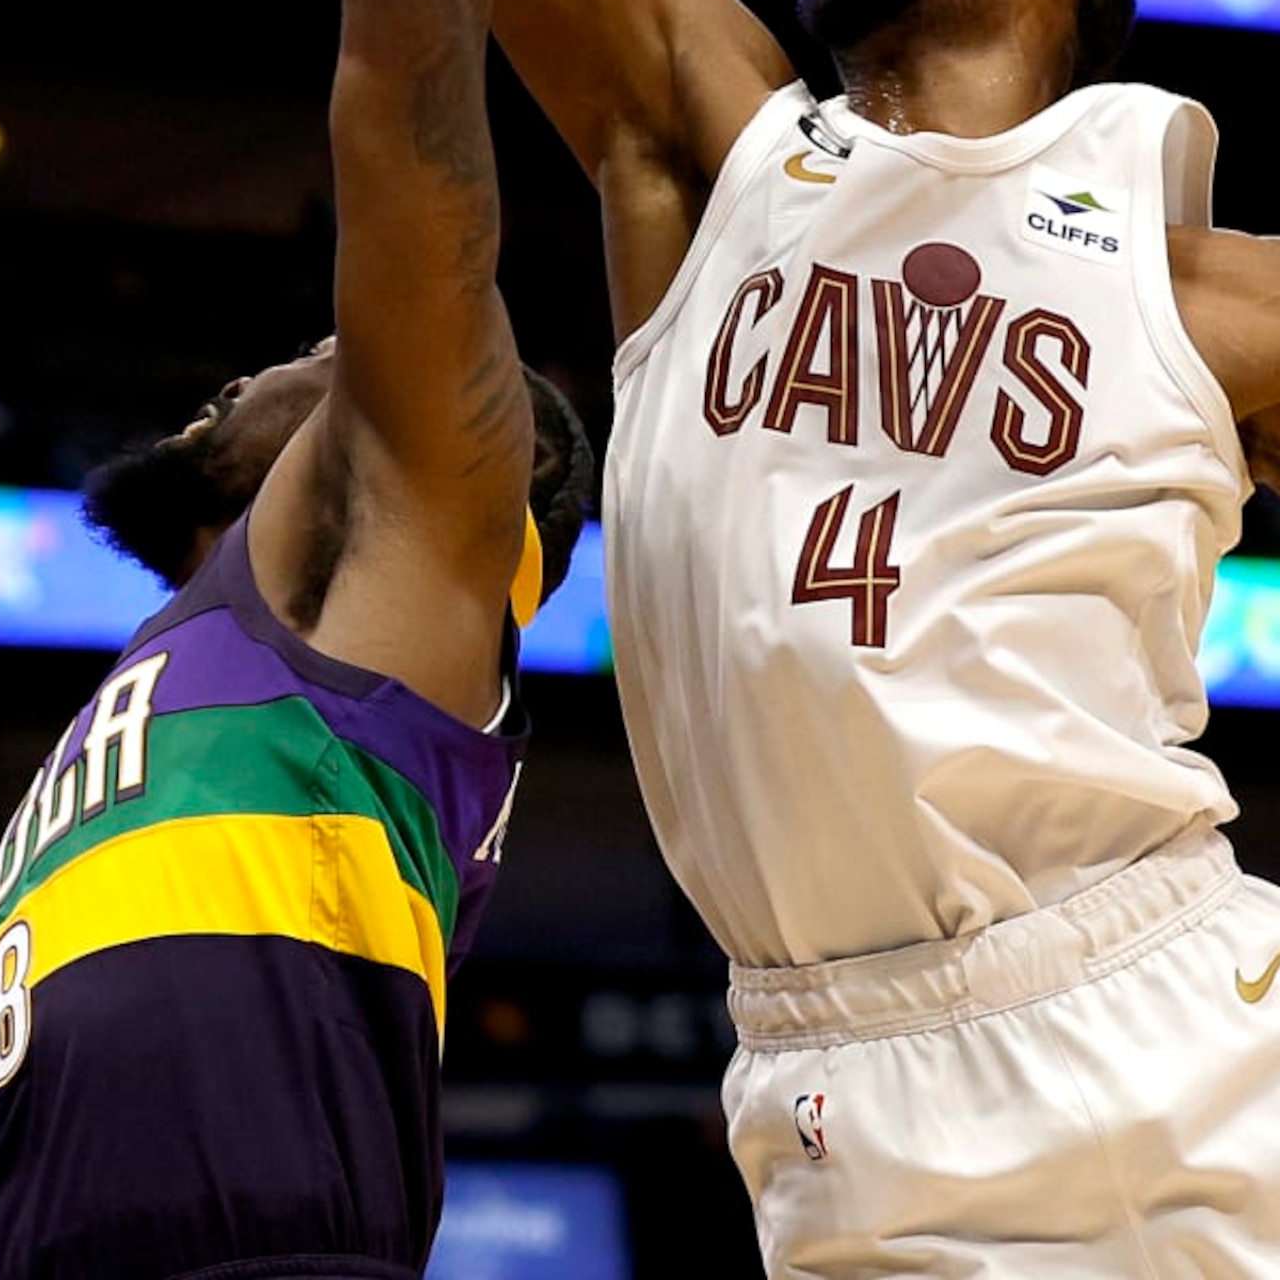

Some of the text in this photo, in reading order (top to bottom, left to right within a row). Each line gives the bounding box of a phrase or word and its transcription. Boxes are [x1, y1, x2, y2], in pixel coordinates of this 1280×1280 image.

[1027, 213, 1119, 253] CLIFFS
[703, 258, 1091, 476] CAVS
[791, 484, 901, 648] 4
